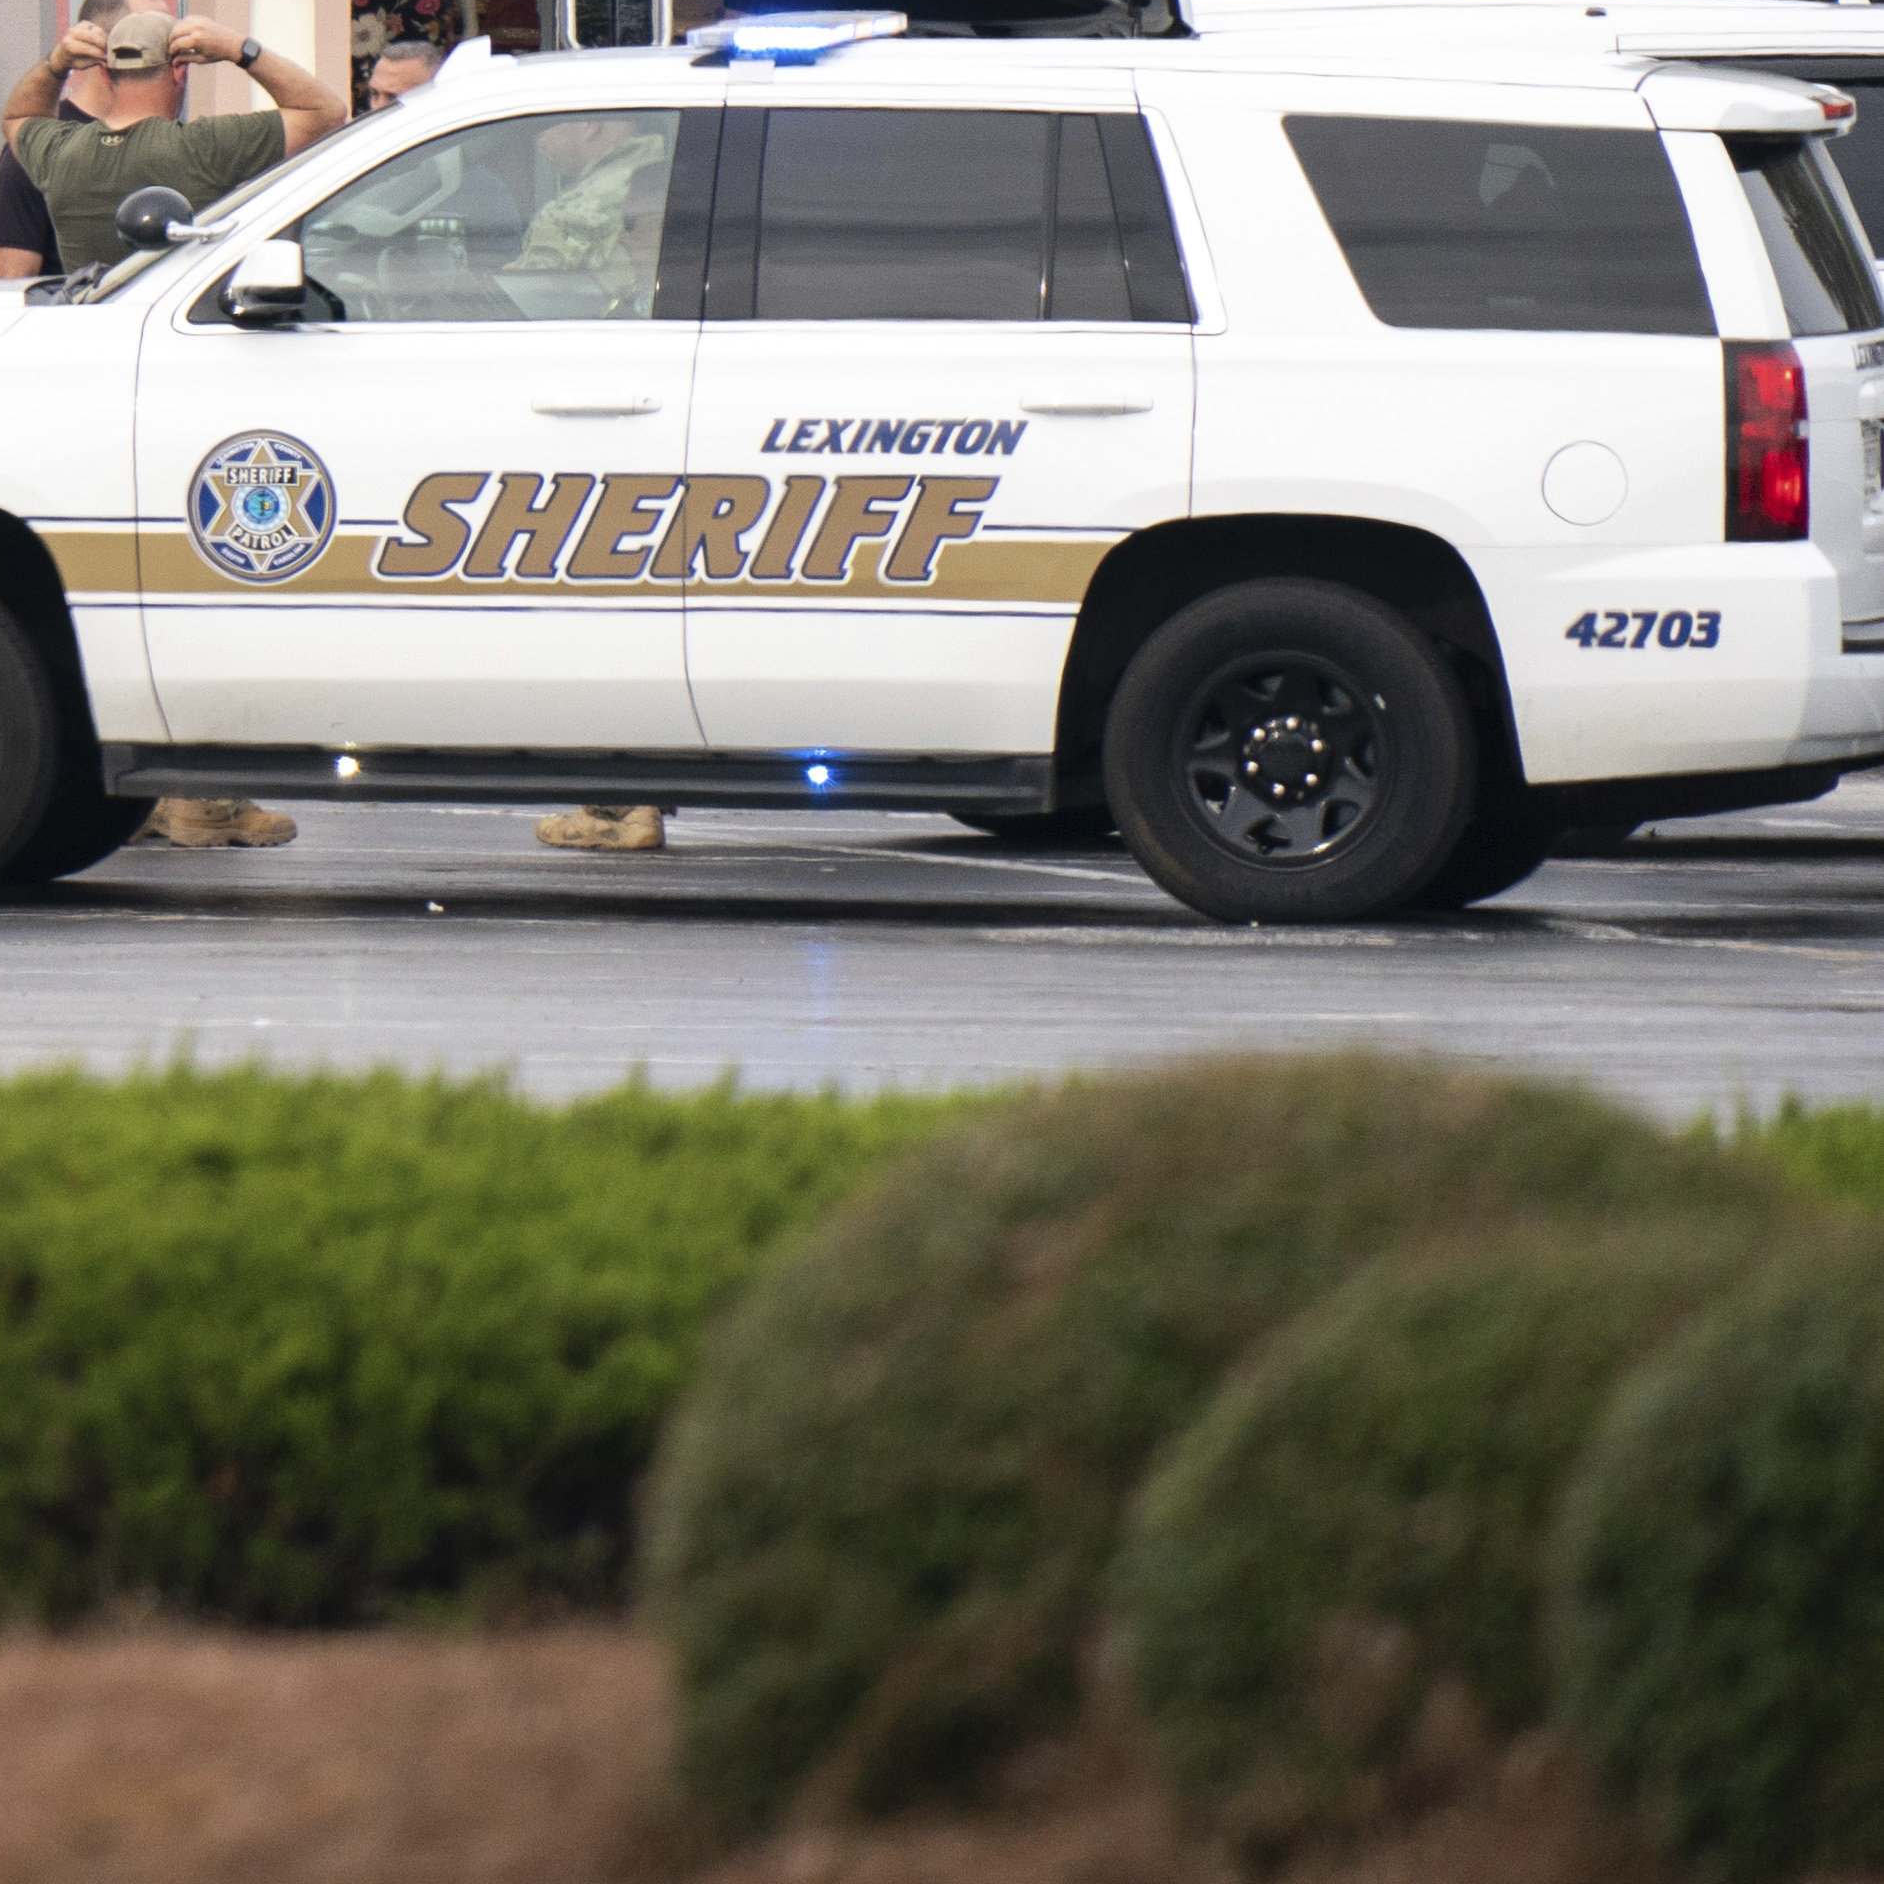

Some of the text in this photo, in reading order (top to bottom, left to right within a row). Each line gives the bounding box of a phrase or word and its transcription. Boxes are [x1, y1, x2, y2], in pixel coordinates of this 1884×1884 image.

[273, 442, 303, 460] COUNTY
[760, 418, 1029, 456] LEXINGTON
[229, 467, 292, 484] SHERIFF
[232, 524, 294, 550] PATROL
[374, 472, 1002, 582] SHERIFF
[1565, 610, 1722, 649] 42703
